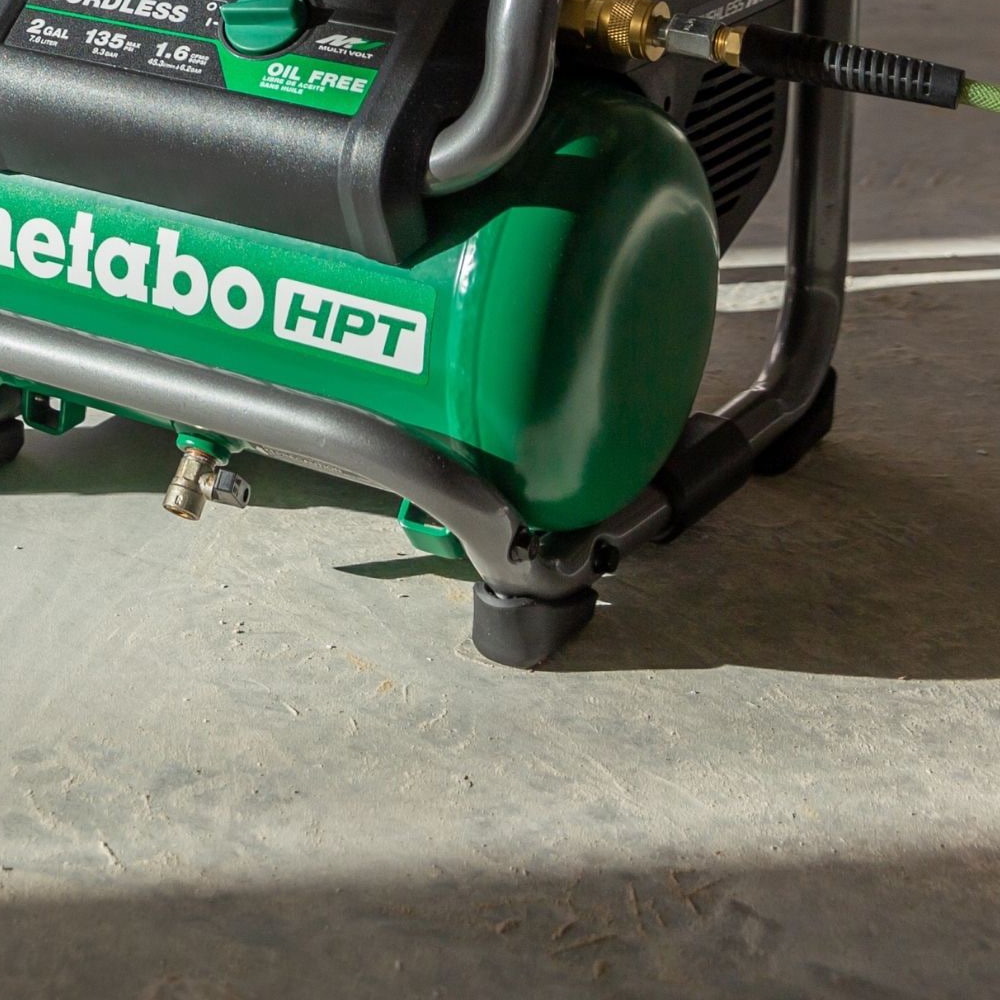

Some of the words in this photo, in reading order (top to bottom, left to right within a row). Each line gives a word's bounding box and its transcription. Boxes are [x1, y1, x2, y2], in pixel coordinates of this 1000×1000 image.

[85, 28, 128, 49] 135
[155, 41, 191, 61] 1.6
[318, 44, 347, 56] MULTI
[348, 50, 374, 60] VOLT
[267, 62, 301, 81] OIL
[307, 69, 368, 94] FREE
[285, 78, 297, 86] DE
[282, 290, 419, 359] HPT
